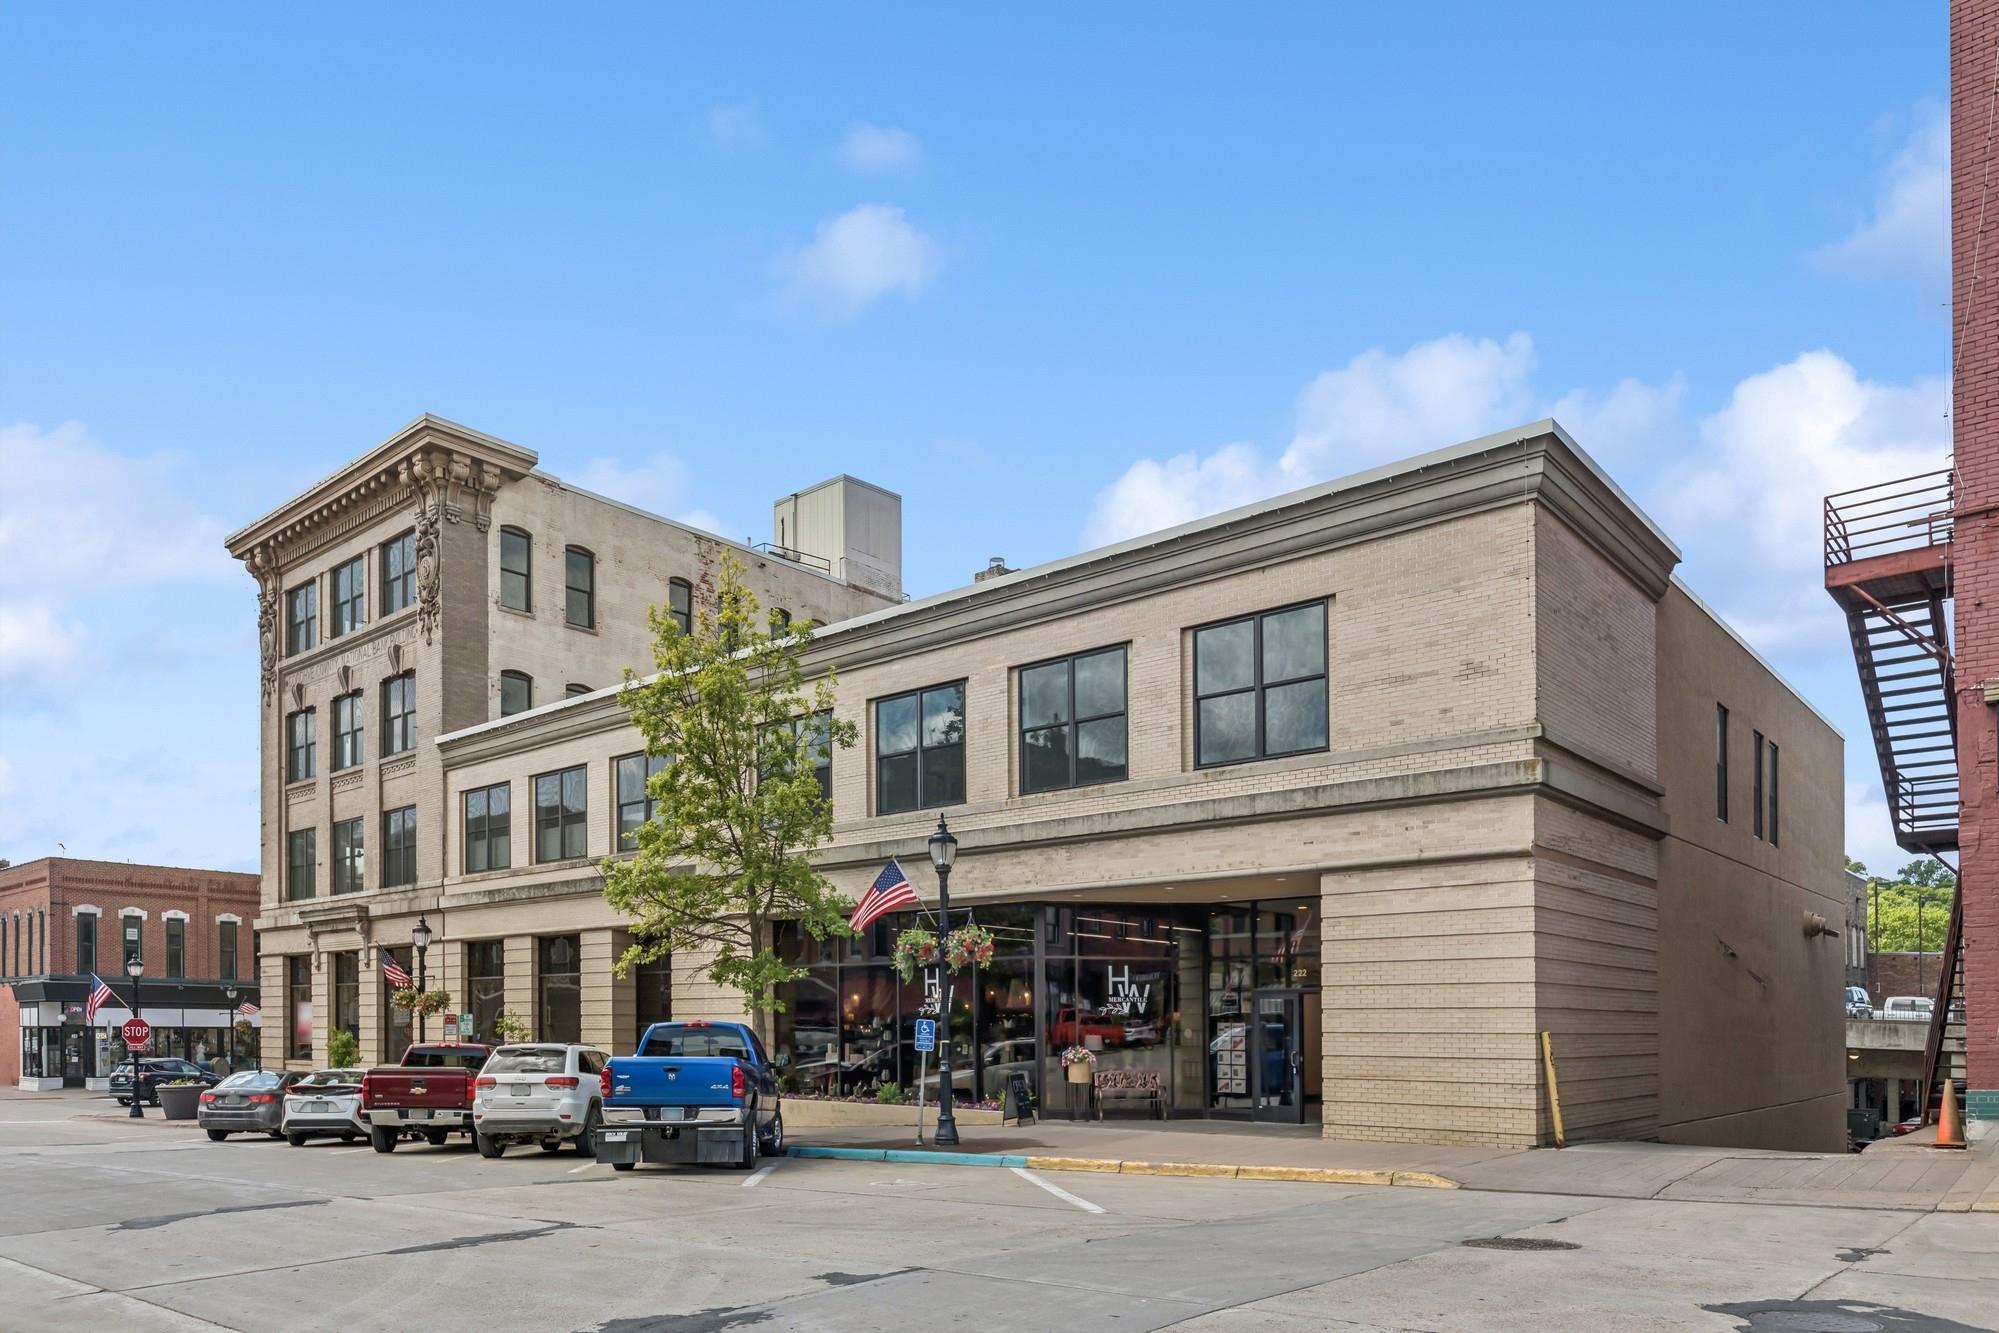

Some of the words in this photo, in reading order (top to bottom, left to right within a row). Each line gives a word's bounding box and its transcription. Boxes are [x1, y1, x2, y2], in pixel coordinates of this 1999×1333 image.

[341, 648, 372, 664] NATIONAL
[373, 638, 389, 654] BANK
[124, 1026, 149, 1037] STOP
